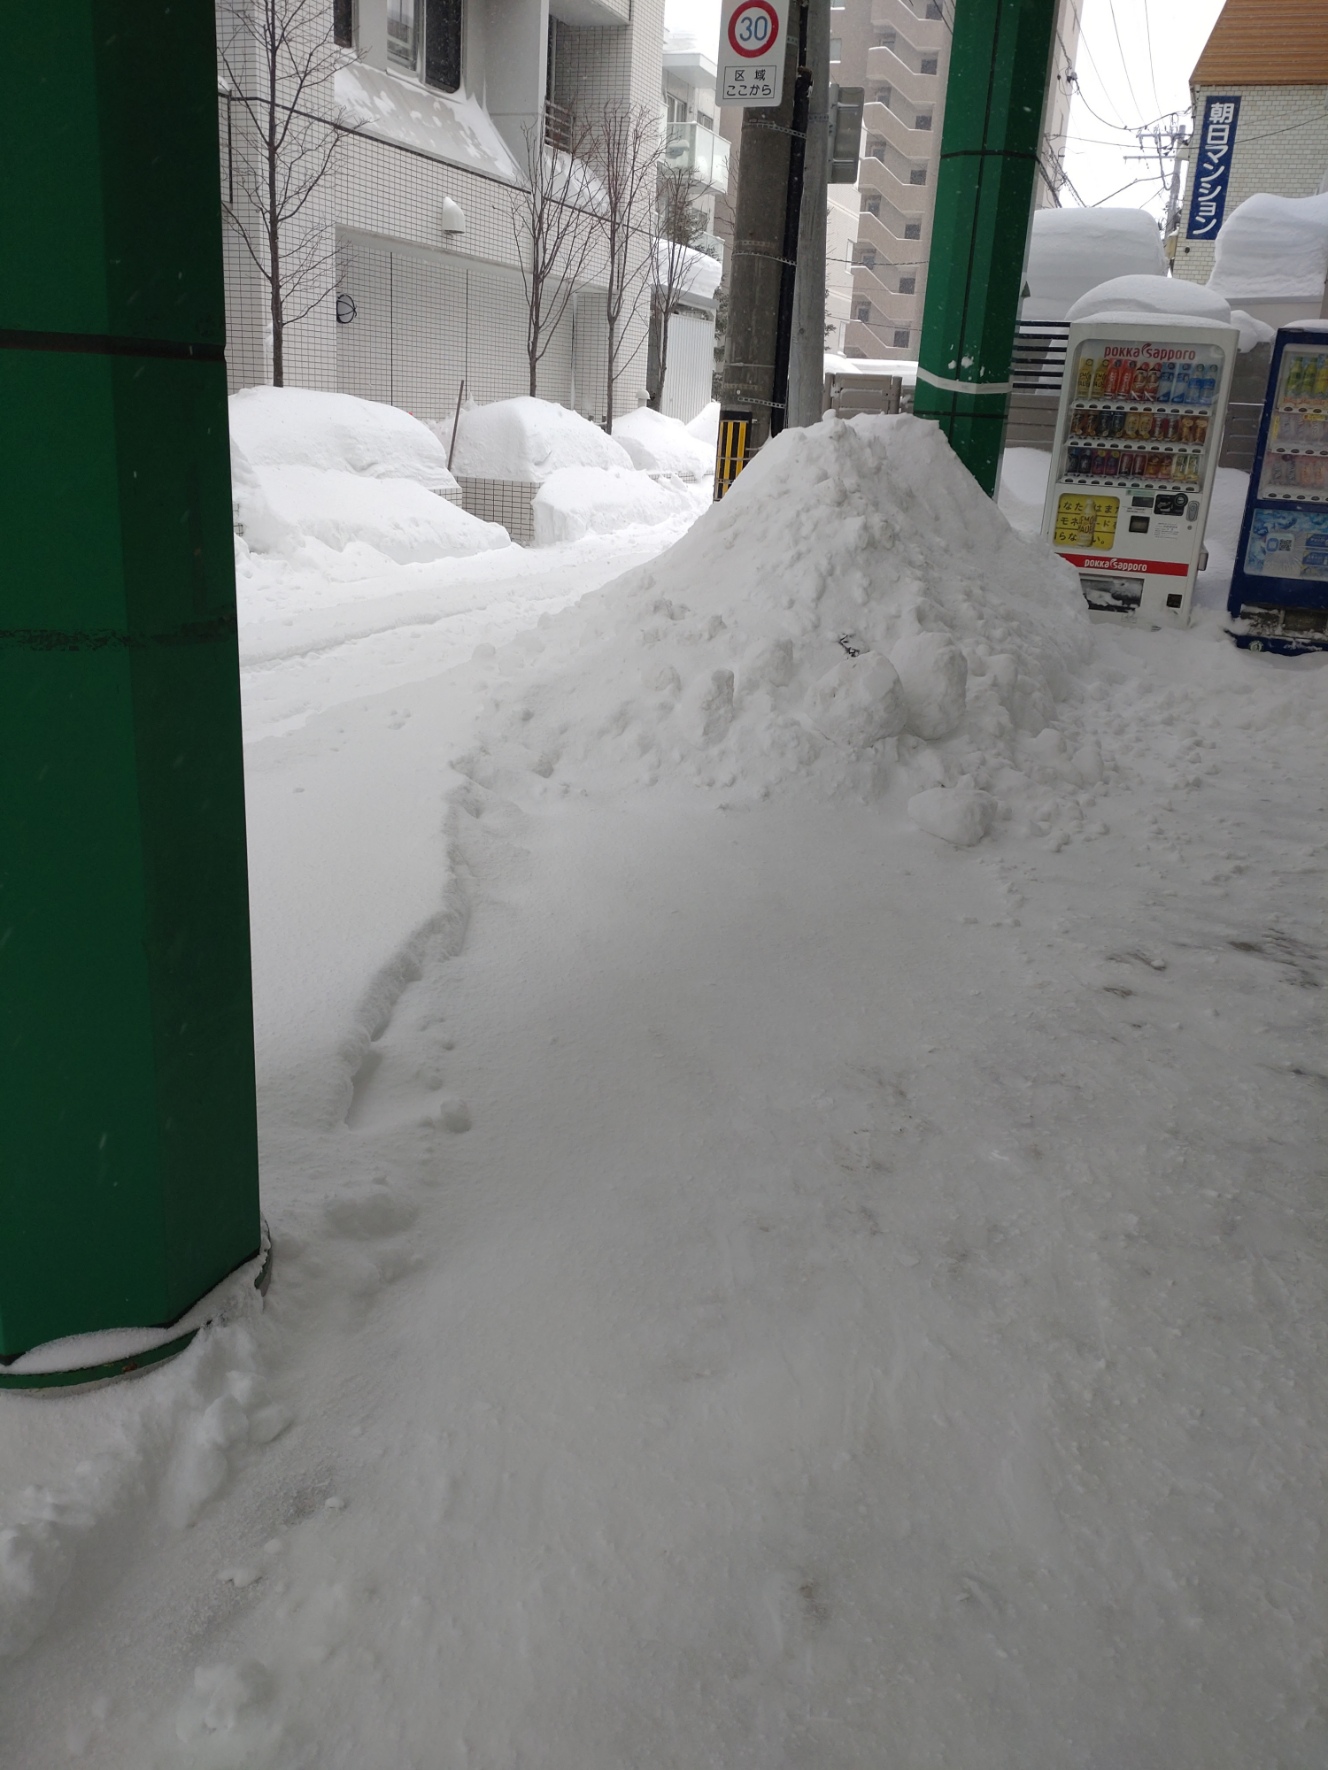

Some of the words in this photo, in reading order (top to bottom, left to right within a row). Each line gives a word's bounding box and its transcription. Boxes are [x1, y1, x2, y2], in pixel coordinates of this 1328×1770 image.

[739, 15, 768, 42] 30
[726, 84, 772, 97] ここから
[1192, 102, 1235, 235] 朝日マンション
